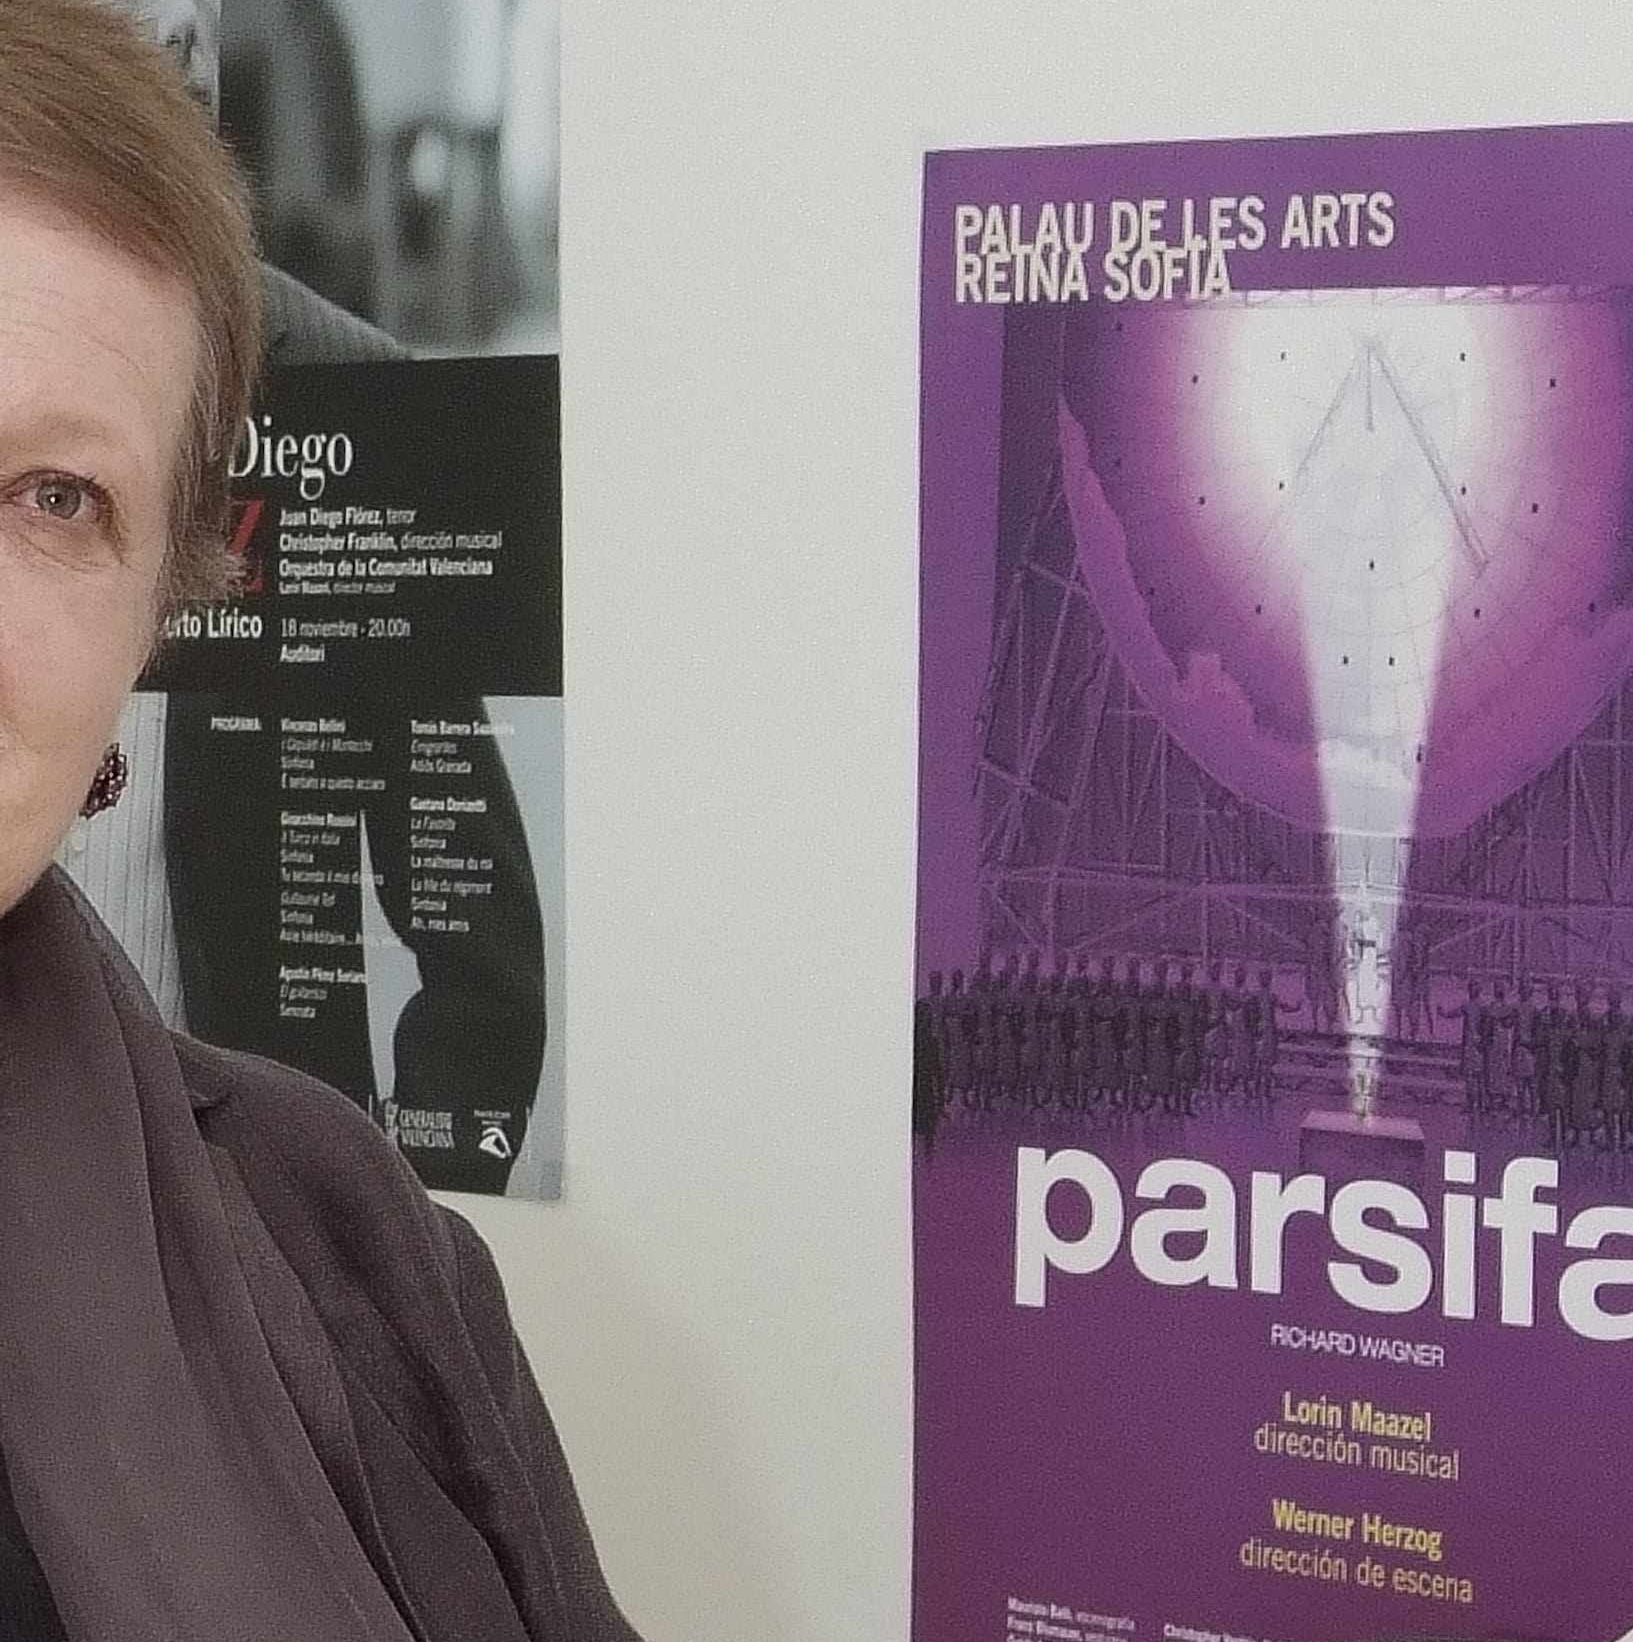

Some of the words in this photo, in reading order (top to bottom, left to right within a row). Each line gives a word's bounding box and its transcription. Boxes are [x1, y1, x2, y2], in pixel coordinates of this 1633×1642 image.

[953, 201, 1096, 258] PALAU
[1110, 199, 1167, 255] DE
[1184, 196, 1267, 252] LES
[1280, 191, 1396, 249] ARTS
[953, 252, 1090, 303] REINA
[228, 414, 354, 501] Diego
[280, 508, 306, 526] Juan
[310, 508, 343, 528] Diego
[337, 559, 353, 577] de
[355, 559, 366, 576] la
[207, 607, 262, 639] Lírico
[281, 618, 297, 638] 18
[1014, 1146, 1633, 1342] parsifa
[1269, 1322, 1356, 1357] RICHARD
[1358, 1332, 1446, 1369] WAGNER
[1283, 1390, 1343, 1430] Lorin
[1350, 1401, 1432, 1444] Maazel
[1254, 1423, 1362, 1466] dirección
[1371, 1439, 1461, 1482] musical
[1272, 1497, 1355, 1543] Werner
[1362, 1511, 1443, 1563] Herzog
[1240, 1538, 1349, 1584] dirección
[1356, 1555, 1387, 1588] de
[1393, 1565, 1474, 1605] escena
